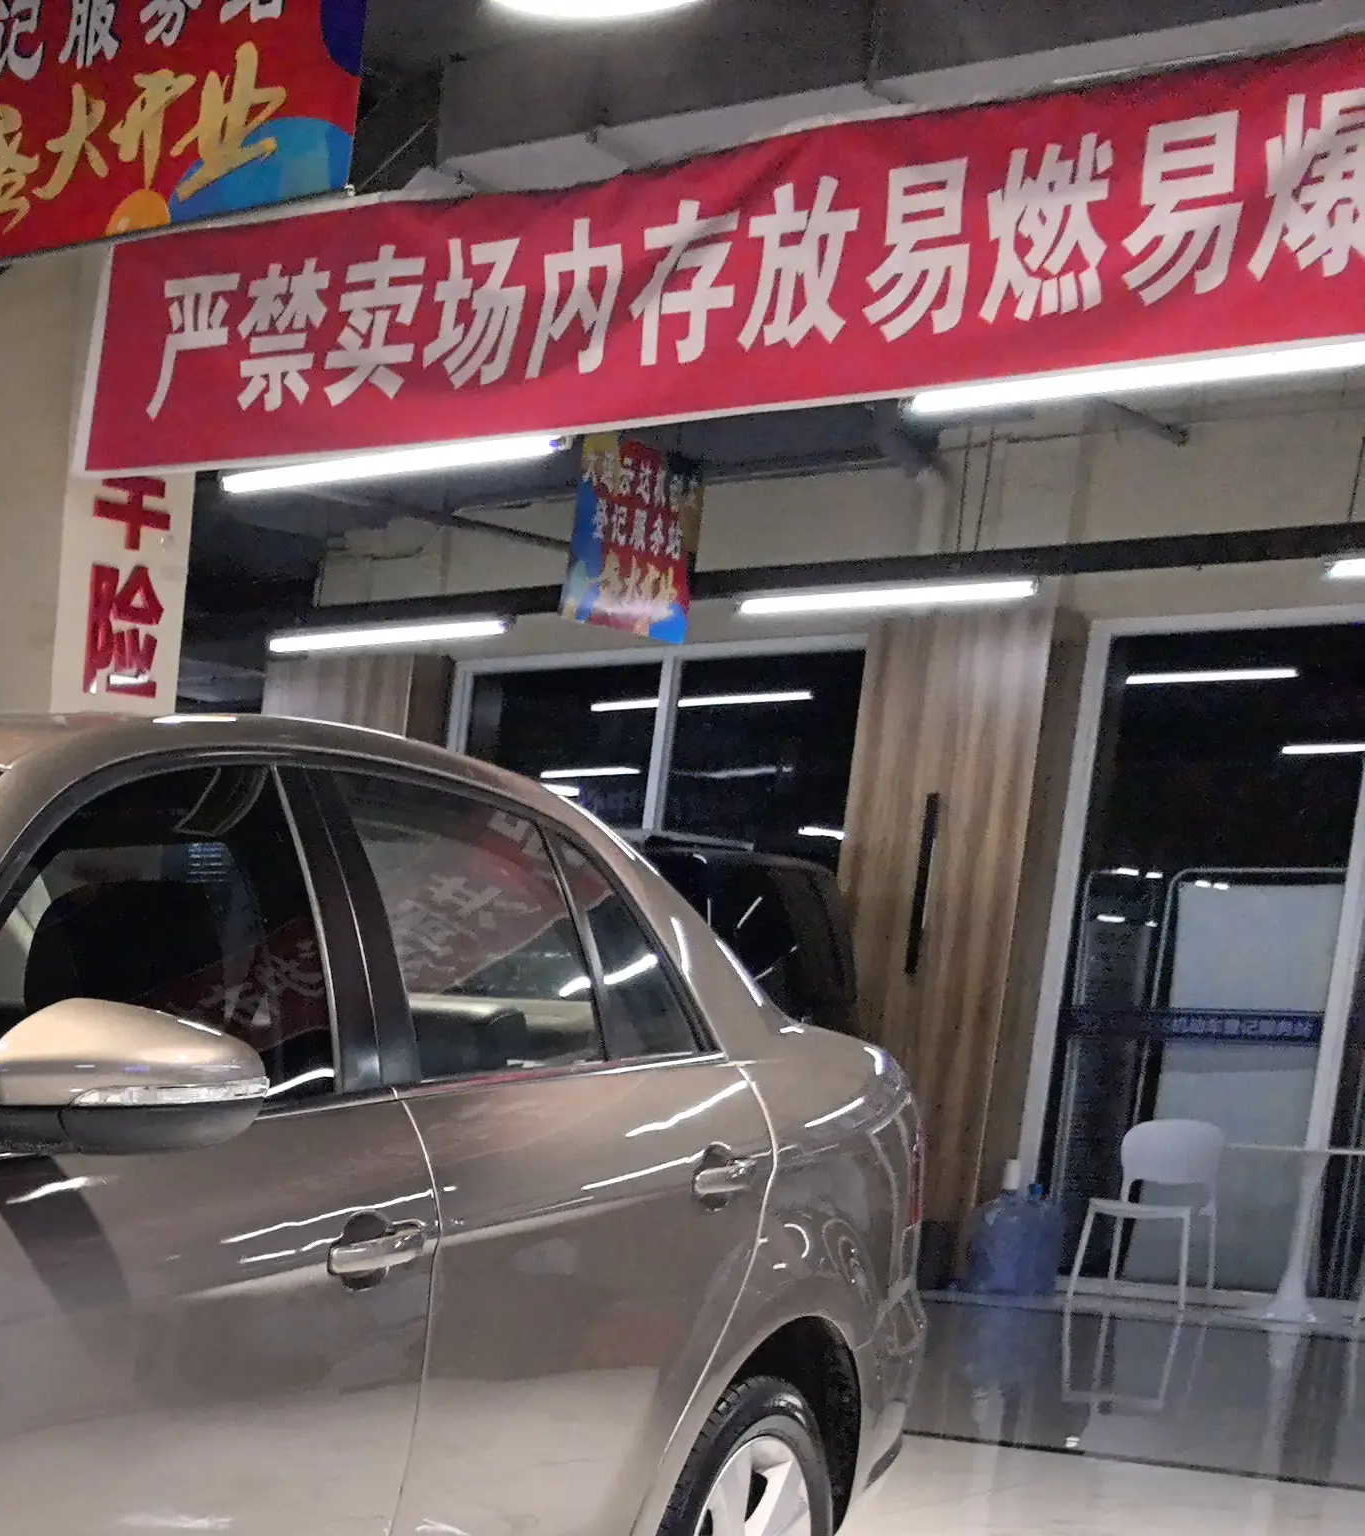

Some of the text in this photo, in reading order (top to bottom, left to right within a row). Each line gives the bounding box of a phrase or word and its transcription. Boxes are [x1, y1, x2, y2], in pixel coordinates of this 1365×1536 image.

[146, 88, 1365, 420] 严禁卖场内存放易燃易爆
